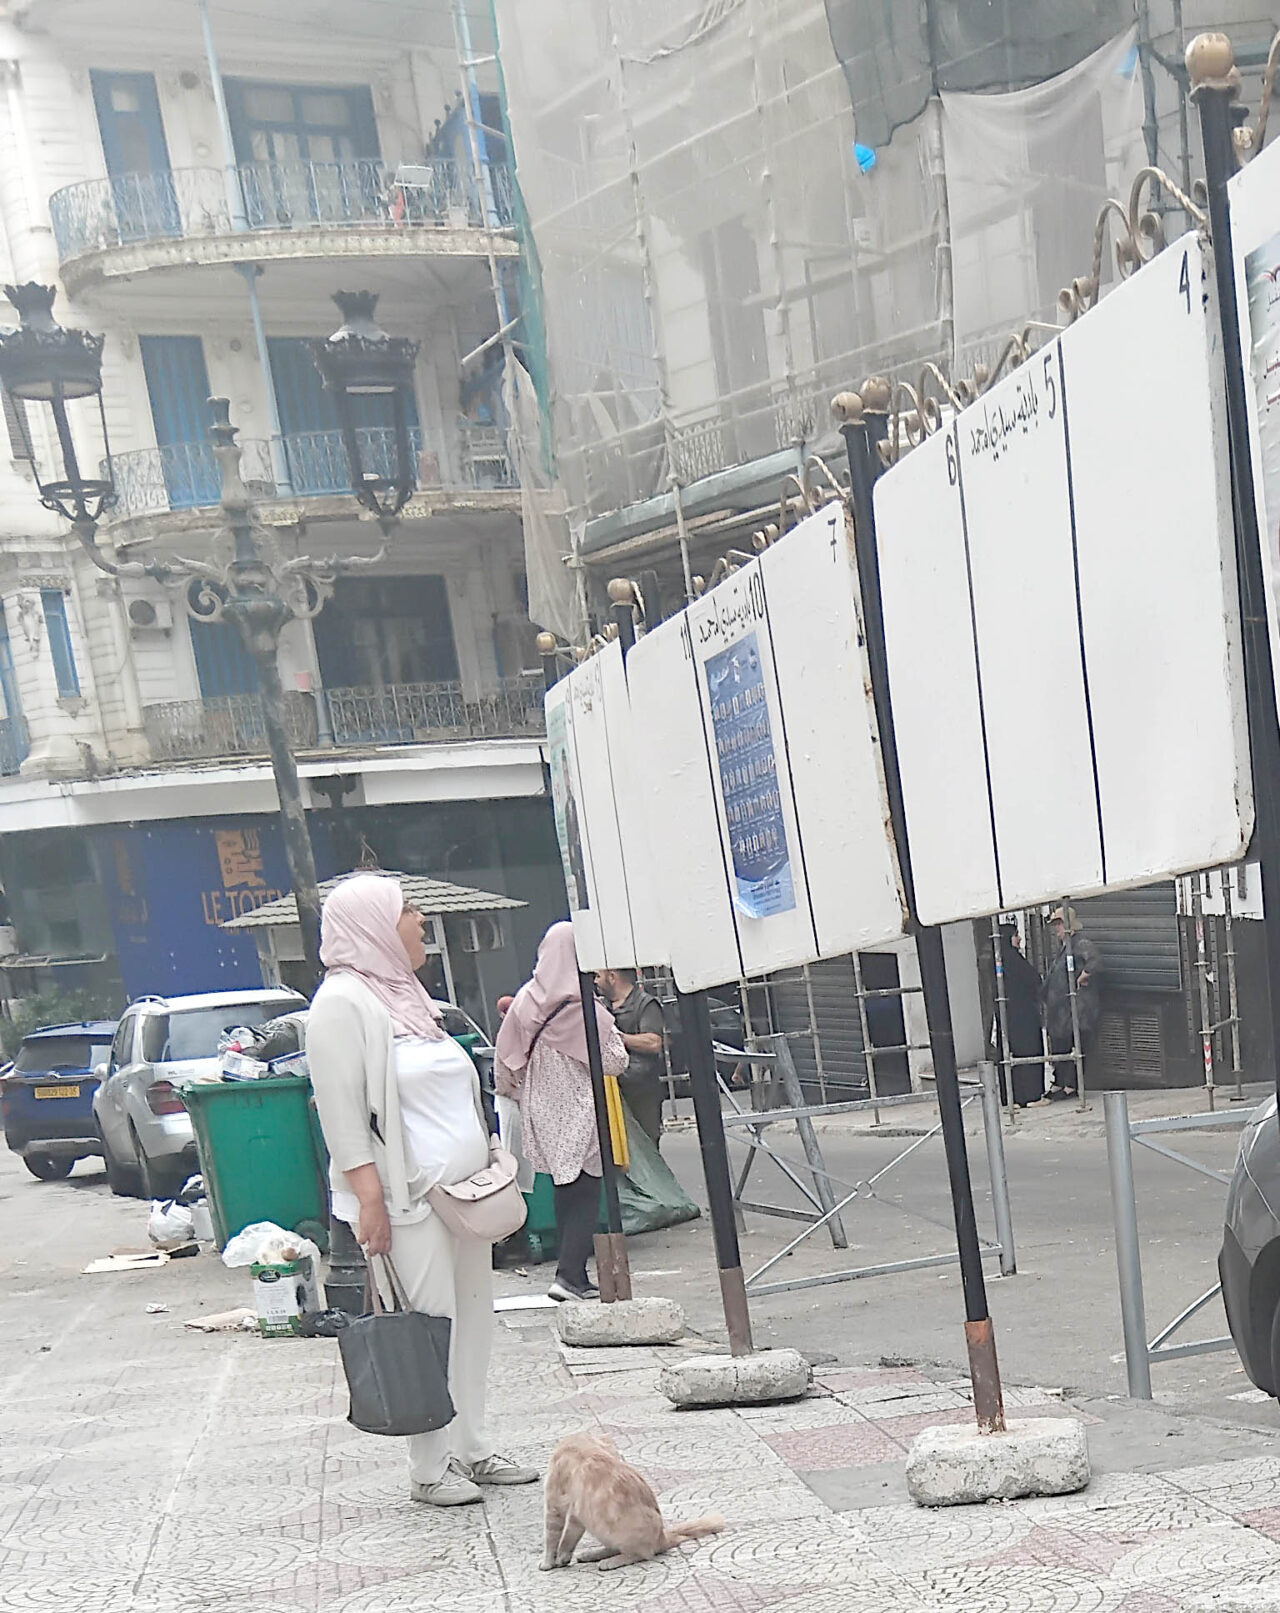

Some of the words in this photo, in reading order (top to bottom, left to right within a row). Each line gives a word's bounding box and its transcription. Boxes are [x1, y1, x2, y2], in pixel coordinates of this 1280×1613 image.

[1179, 250, 1190, 314] 4
[1043, 353, 1056, 419] 5
[945, 434, 957, 486] 6
[827, 517, 837, 563] 7
[749, 571, 764, 621] 10
[202, 891, 224, 925] LE
[225, 889, 284, 917] TOT
